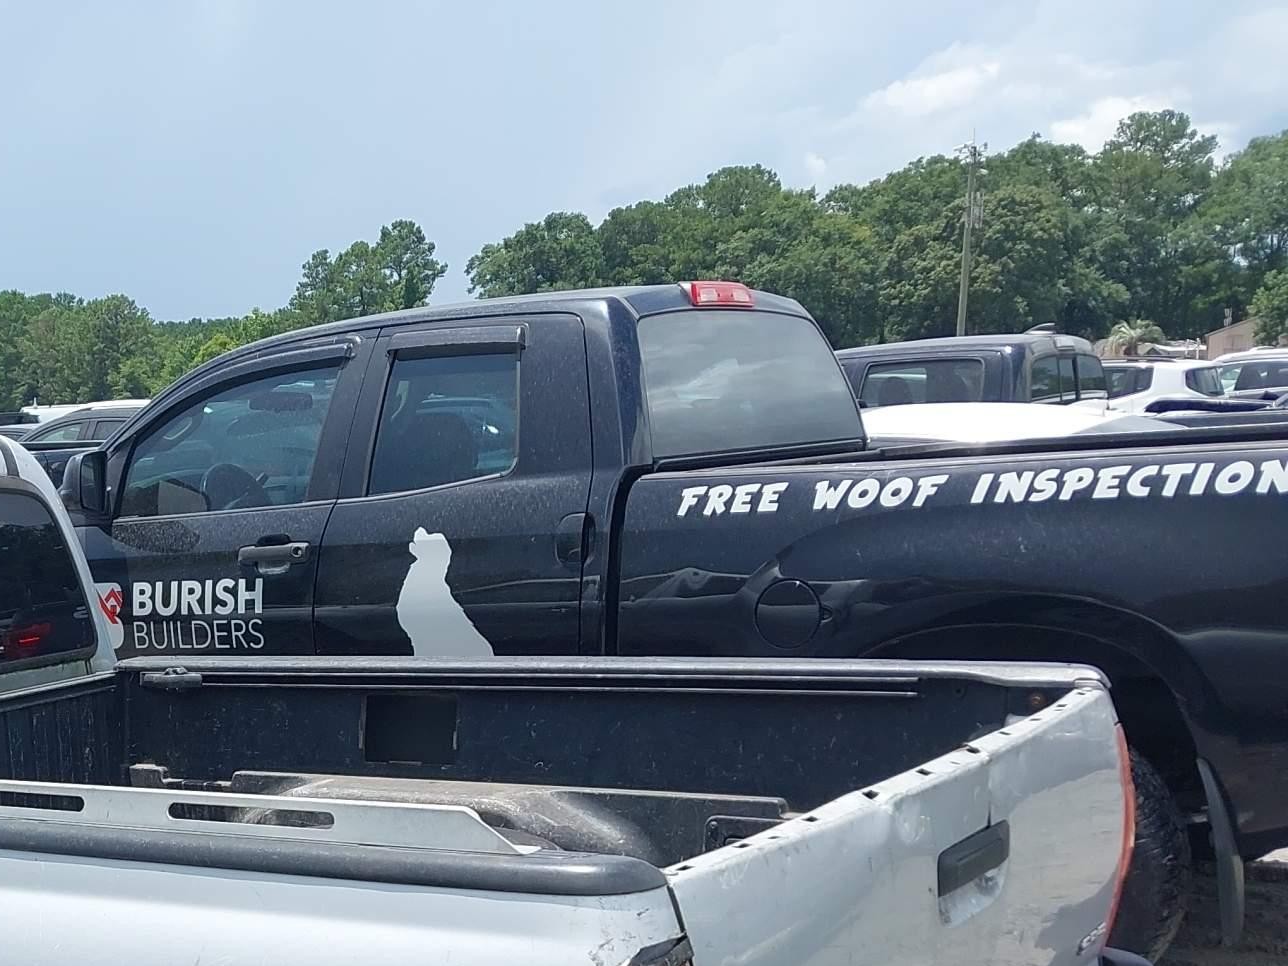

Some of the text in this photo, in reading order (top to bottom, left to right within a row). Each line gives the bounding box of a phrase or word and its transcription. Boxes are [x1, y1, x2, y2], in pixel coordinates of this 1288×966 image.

[677, 482, 789, 516] FREE
[813, 475, 949, 510] WOOF
[132, 578, 263, 616] BURISH
[133, 619, 265, 649] BUILDERS
